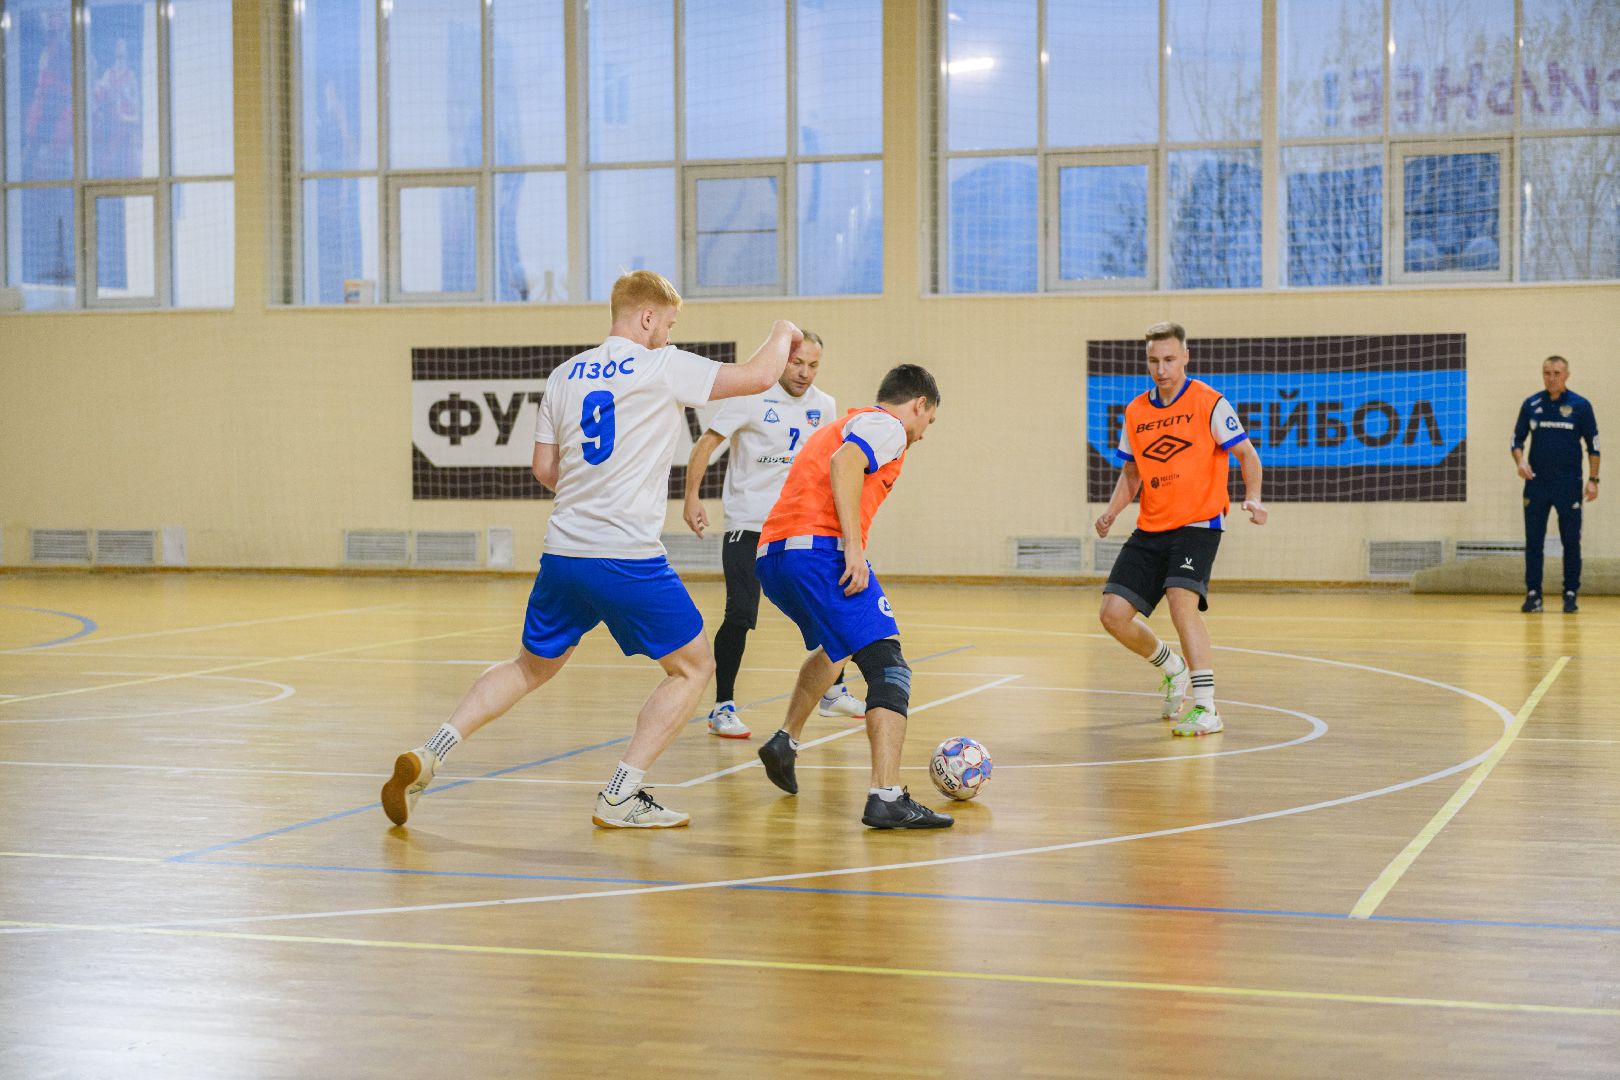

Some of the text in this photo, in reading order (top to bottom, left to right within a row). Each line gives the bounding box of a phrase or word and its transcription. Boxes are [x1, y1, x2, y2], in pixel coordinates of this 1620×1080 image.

[579, 390, 615, 466] 9
[1136, 413, 1194, 434] BETCITY
[788, 427, 801, 451] 7
[934, 759, 957, 790] SELECT
